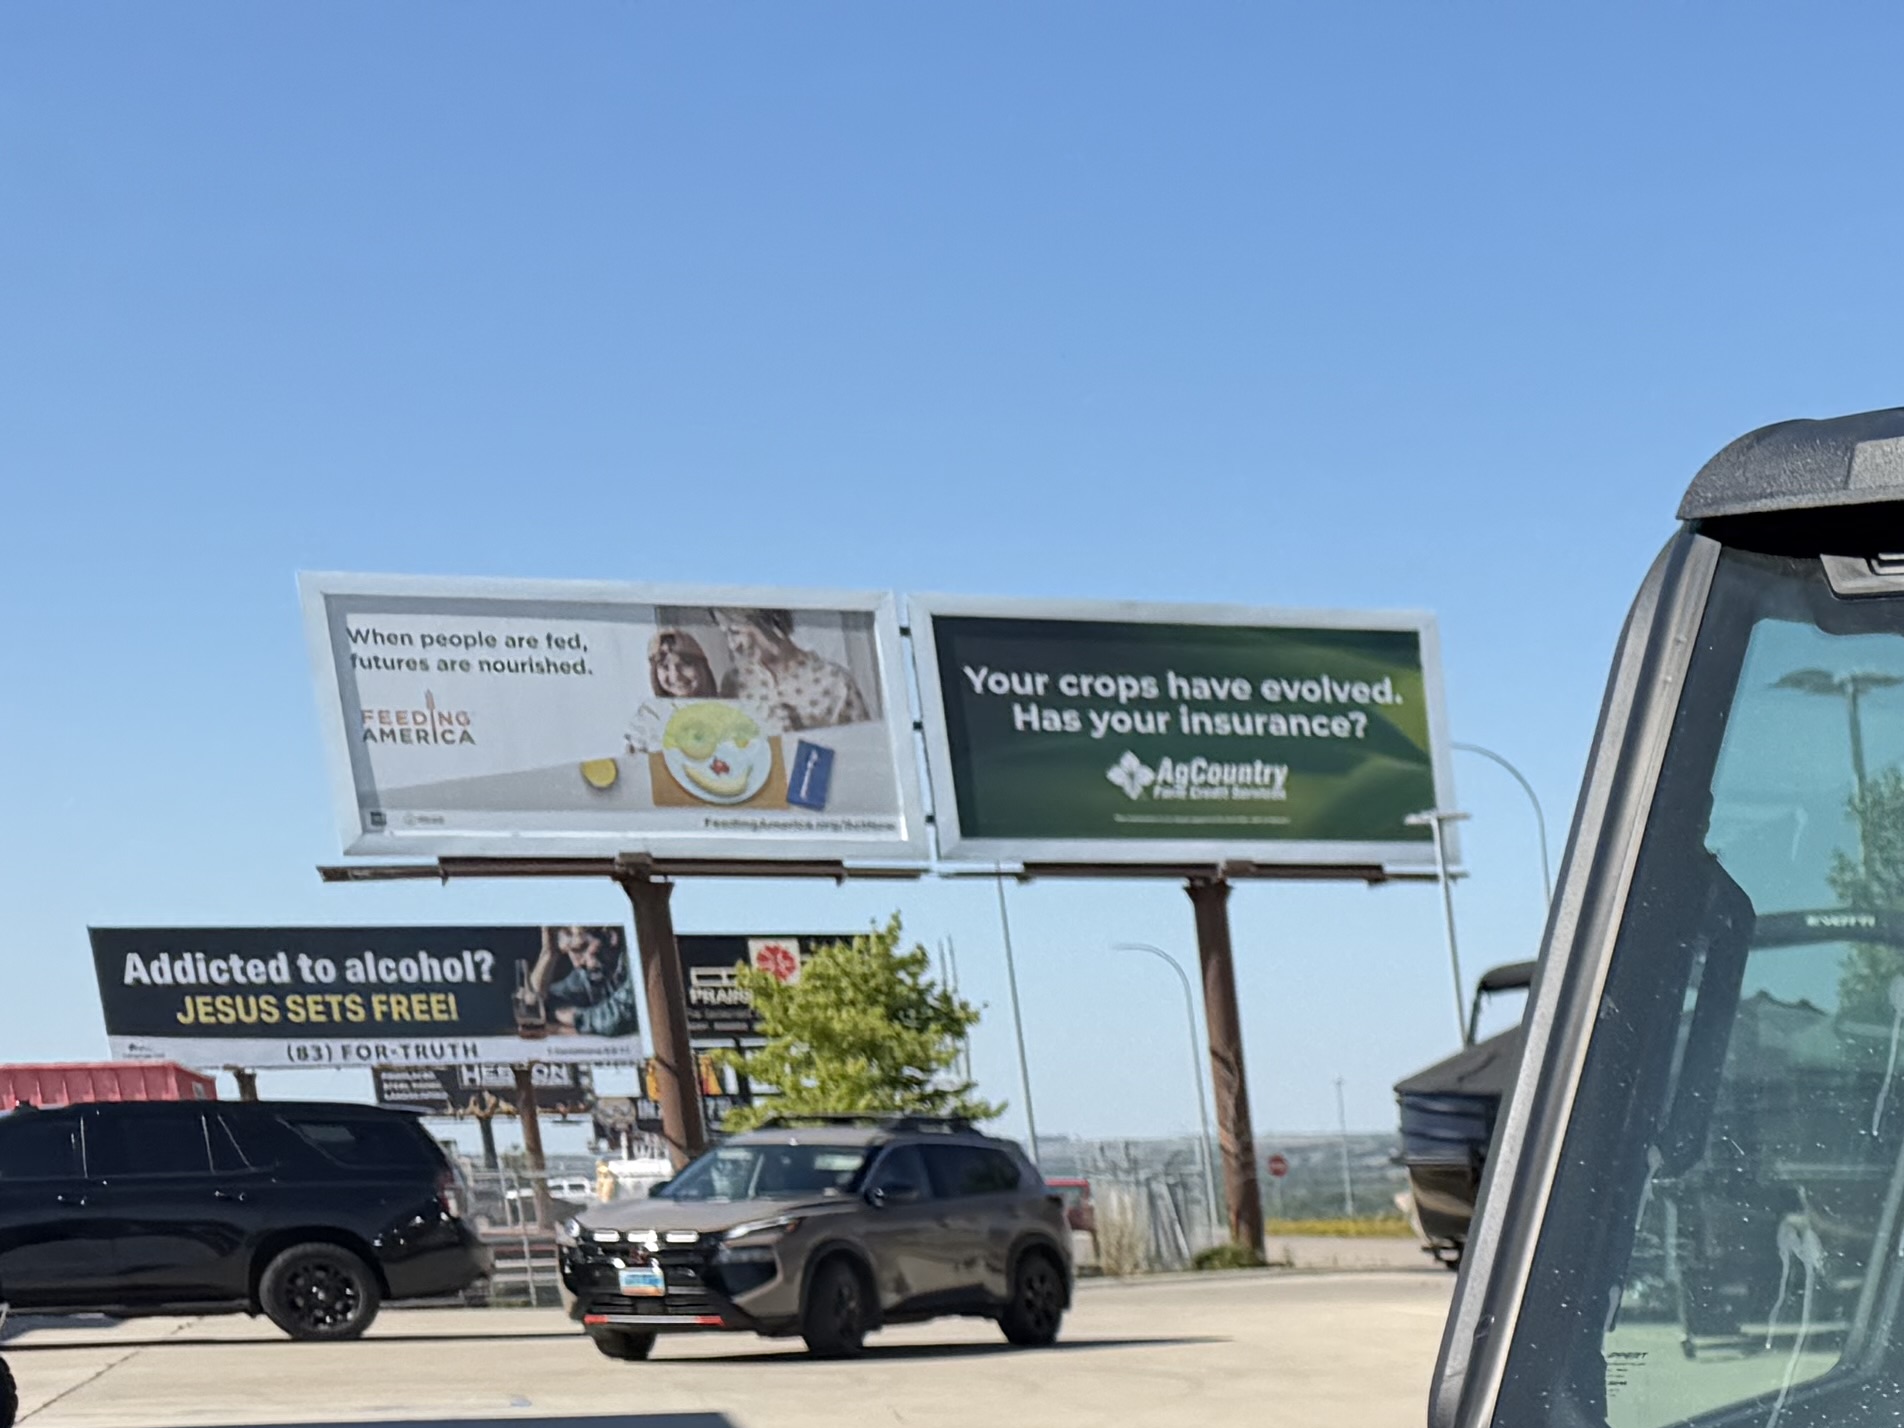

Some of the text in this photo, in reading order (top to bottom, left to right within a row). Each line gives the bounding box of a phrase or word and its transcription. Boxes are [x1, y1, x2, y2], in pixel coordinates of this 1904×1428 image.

[346, 627, 588, 652] When people are fed,
[350, 653, 593, 675] futures are nourished.
[962, 665, 1403, 704] Your crops have evolved.
[361, 708, 472, 727] FEEDING
[1012, 702, 1368, 739] Has your insurance?
[362, 727, 476, 745] AMERICA
[1155, 755, 1288, 788] AgCountry
[123, 950, 496, 986] Addicted to alcohol?
[176, 992, 460, 1024] JESUS SETS FREE!
[342, 1042, 480, 1061] FOR-TRUTH
